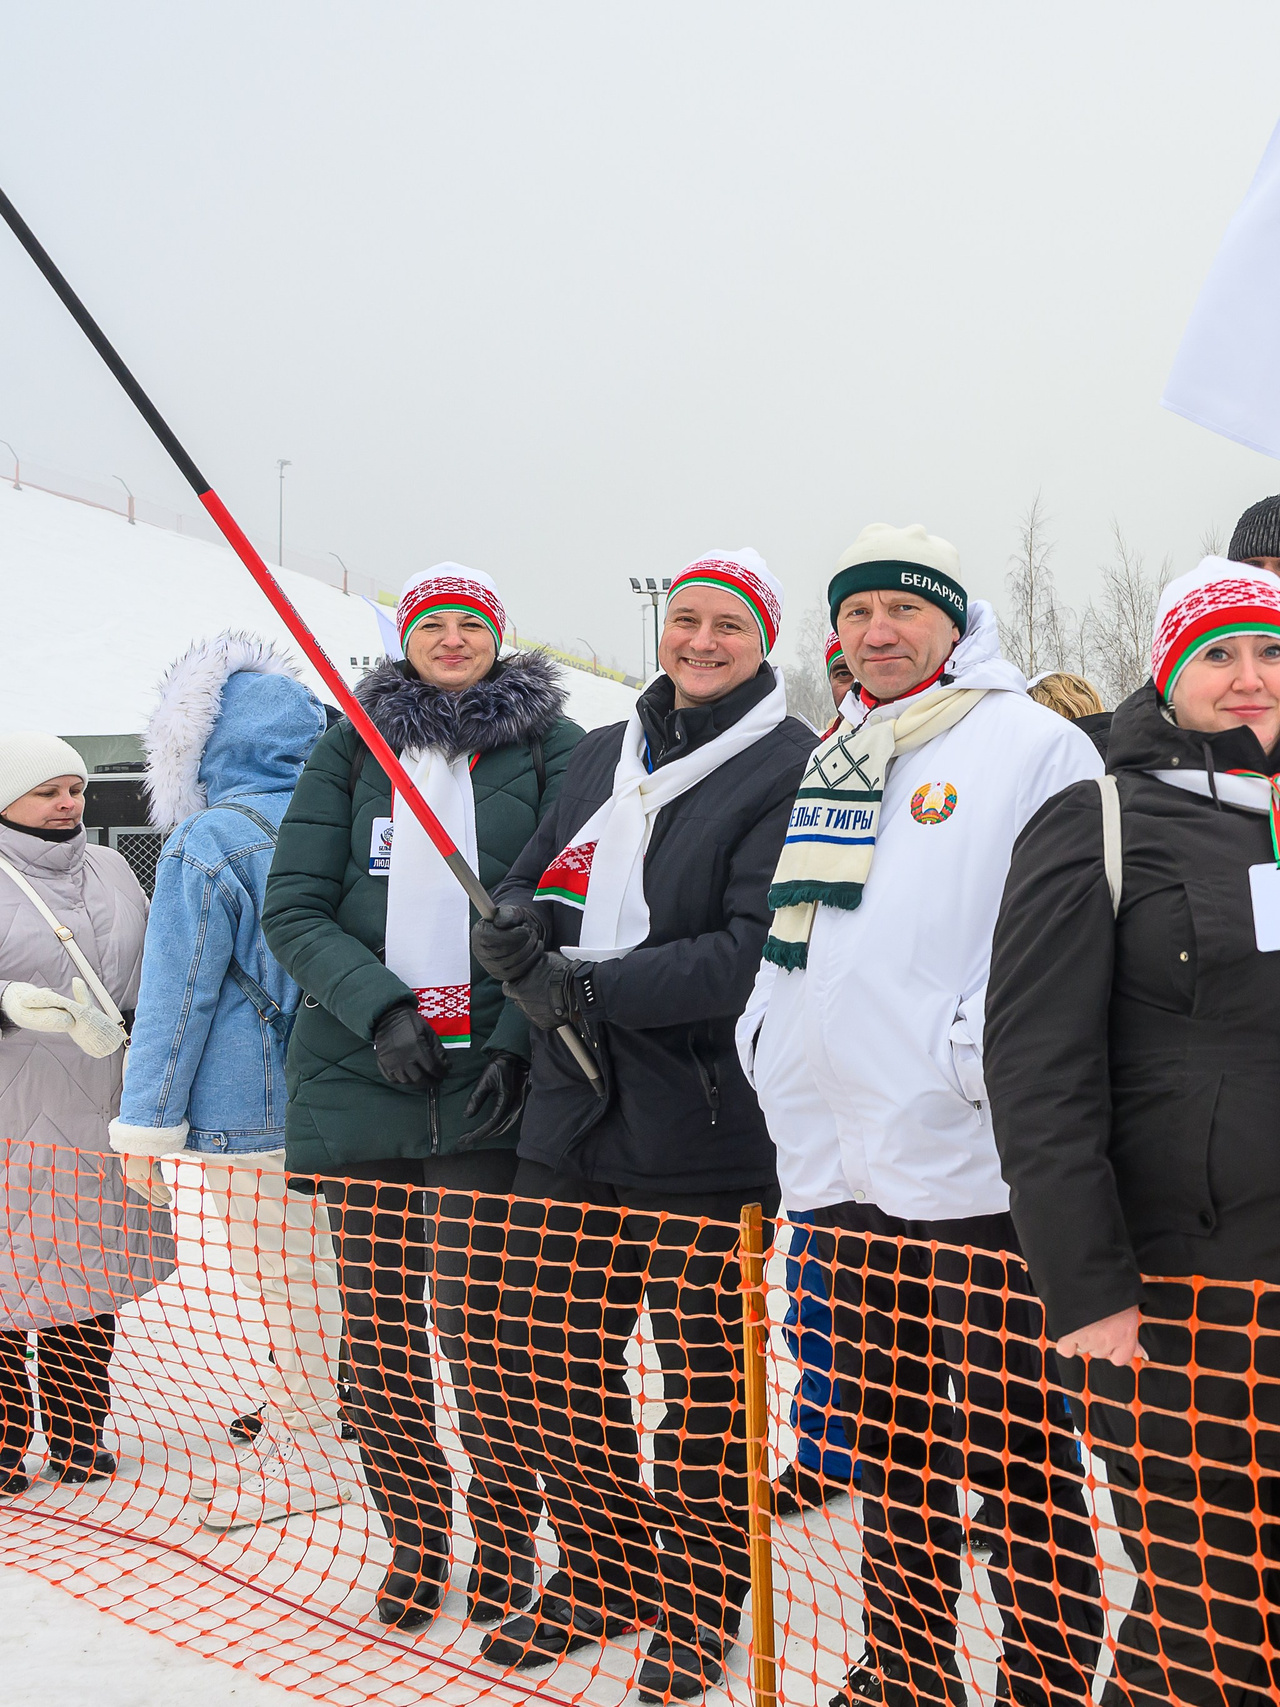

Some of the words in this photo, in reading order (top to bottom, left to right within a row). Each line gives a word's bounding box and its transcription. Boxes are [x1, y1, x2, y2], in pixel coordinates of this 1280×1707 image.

[900, 572, 964, 612] БЕЛАРУСЬ
[825, 807, 874, 830] ТИГРЫ
[373, 859, 390, 868] ЛЮД
